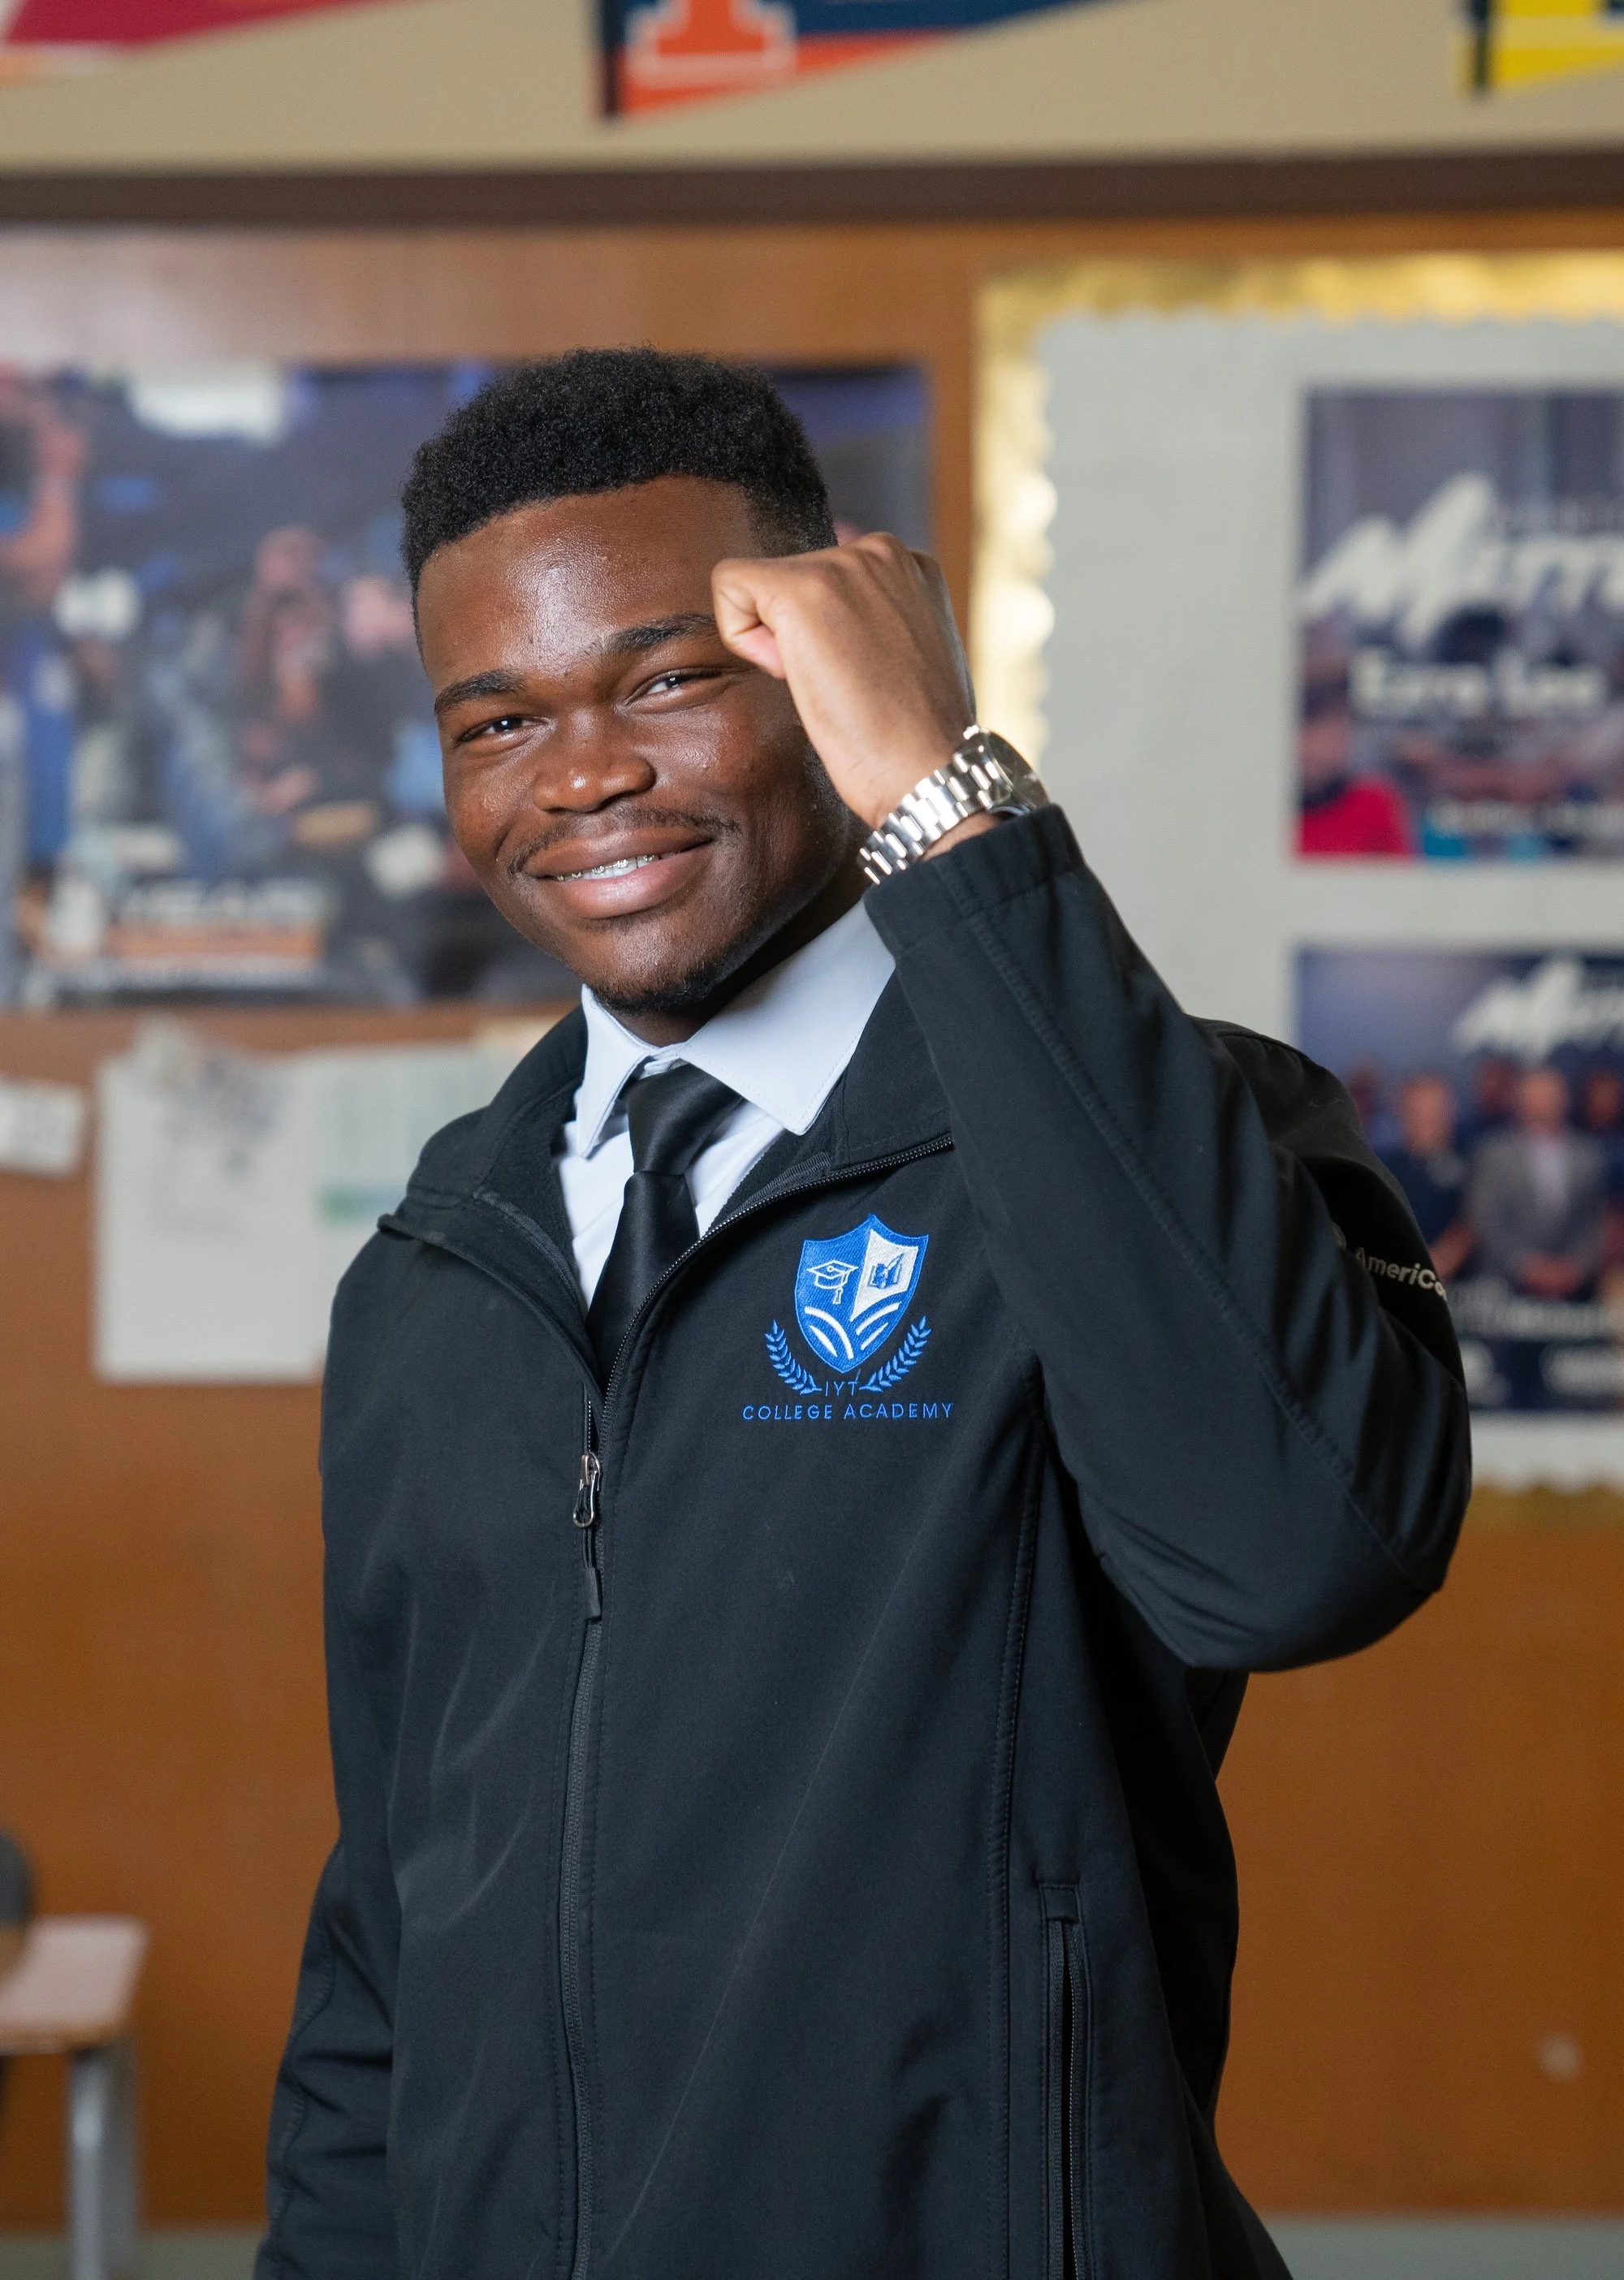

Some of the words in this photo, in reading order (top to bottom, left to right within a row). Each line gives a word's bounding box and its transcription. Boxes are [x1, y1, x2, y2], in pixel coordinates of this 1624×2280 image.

[1354, 1246, 1447, 1302] AmeriCo
[825, 1381, 857, 1397] IYT
[742, 1404, 833, 1421] COLLEGE
[843, 1402, 954, 1419] ACADEMY
